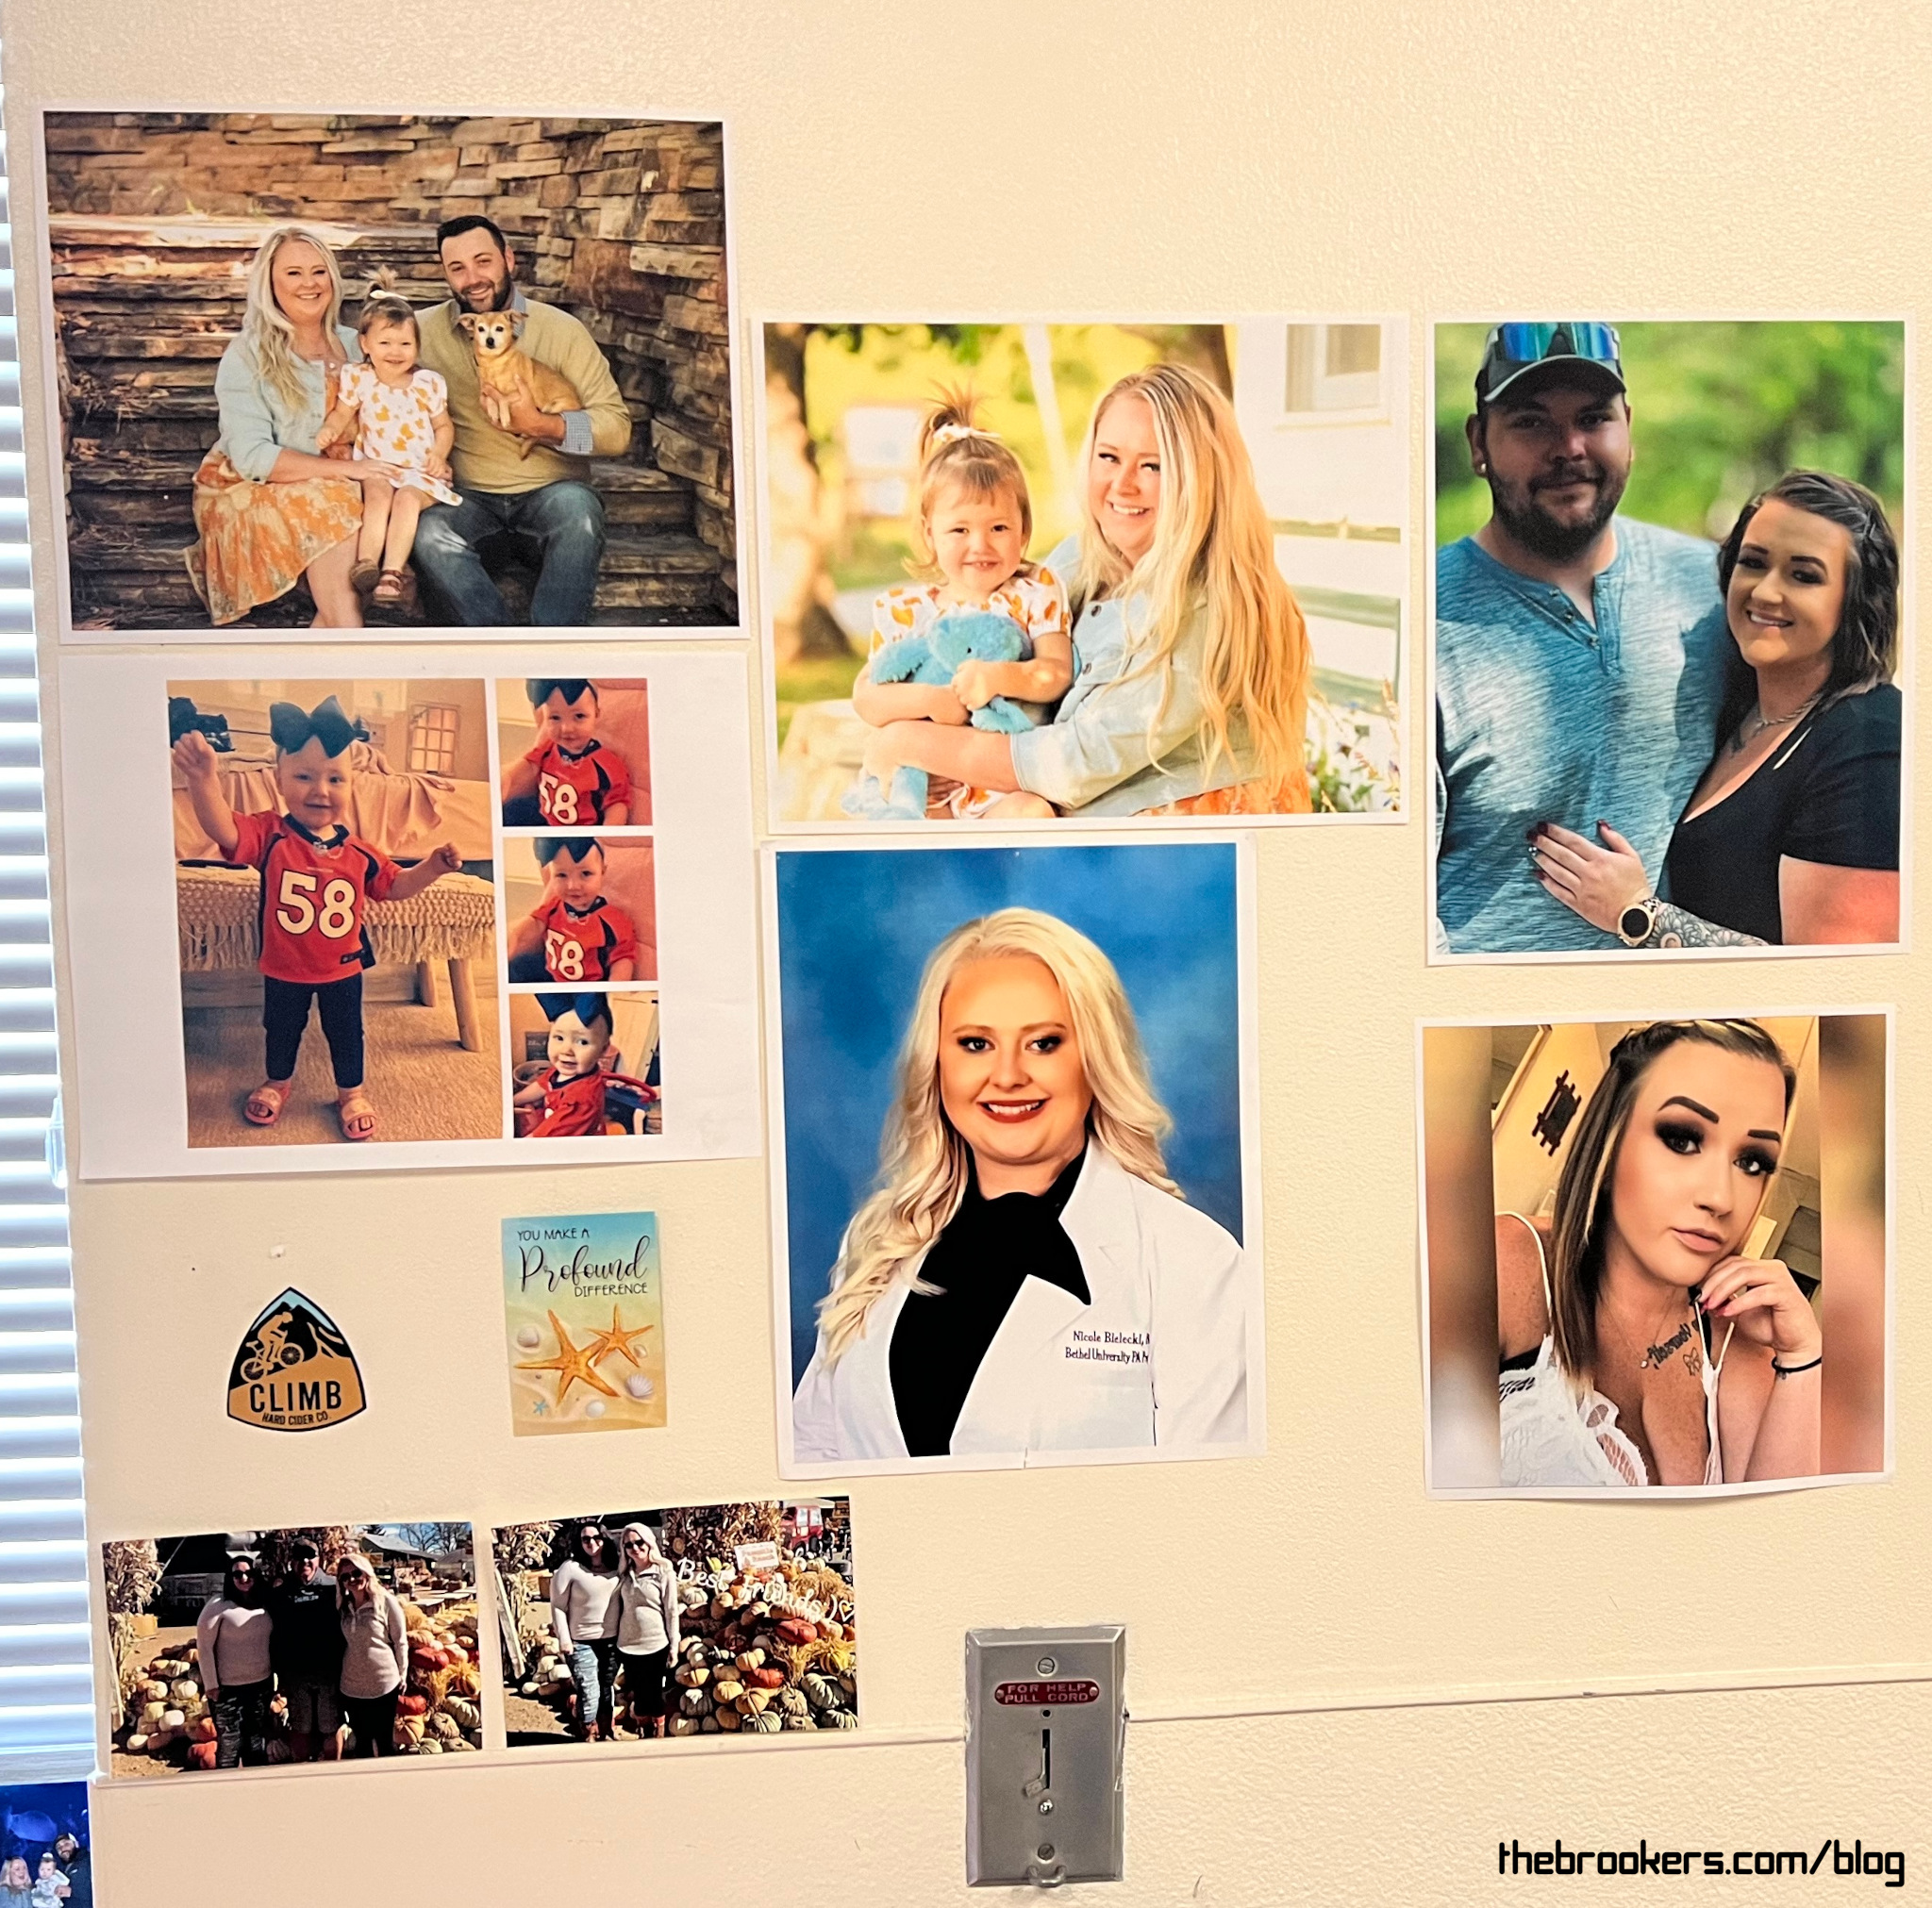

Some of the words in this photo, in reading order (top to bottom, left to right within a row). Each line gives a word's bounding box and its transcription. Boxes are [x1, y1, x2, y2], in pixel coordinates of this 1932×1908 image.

[275, 868, 357, 939] 58
[516, 1229, 541, 1241] YOU
[543, 1228, 577, 1240] MAKE
[581, 1228, 590, 1238] A
[518, 1235, 651, 1293] Profound
[575, 1282, 649, 1298] DIFFERENCE
[1073, 1330, 1102, 1342] Nicole
[1065, 1346, 1091, 1360] Bethel
[249, 1380, 342, 1413] CLIMB
[261, 1412, 286, 1425] HARD
[288, 1414, 314, 1425] CIDER
[1007, 1684, 1040, 1694] FOR
[1046, 1683, 1087, 1692] HELP
[1005, 1694, 1041, 1703] PULL
[1047, 1692, 1089, 1702] CORD
